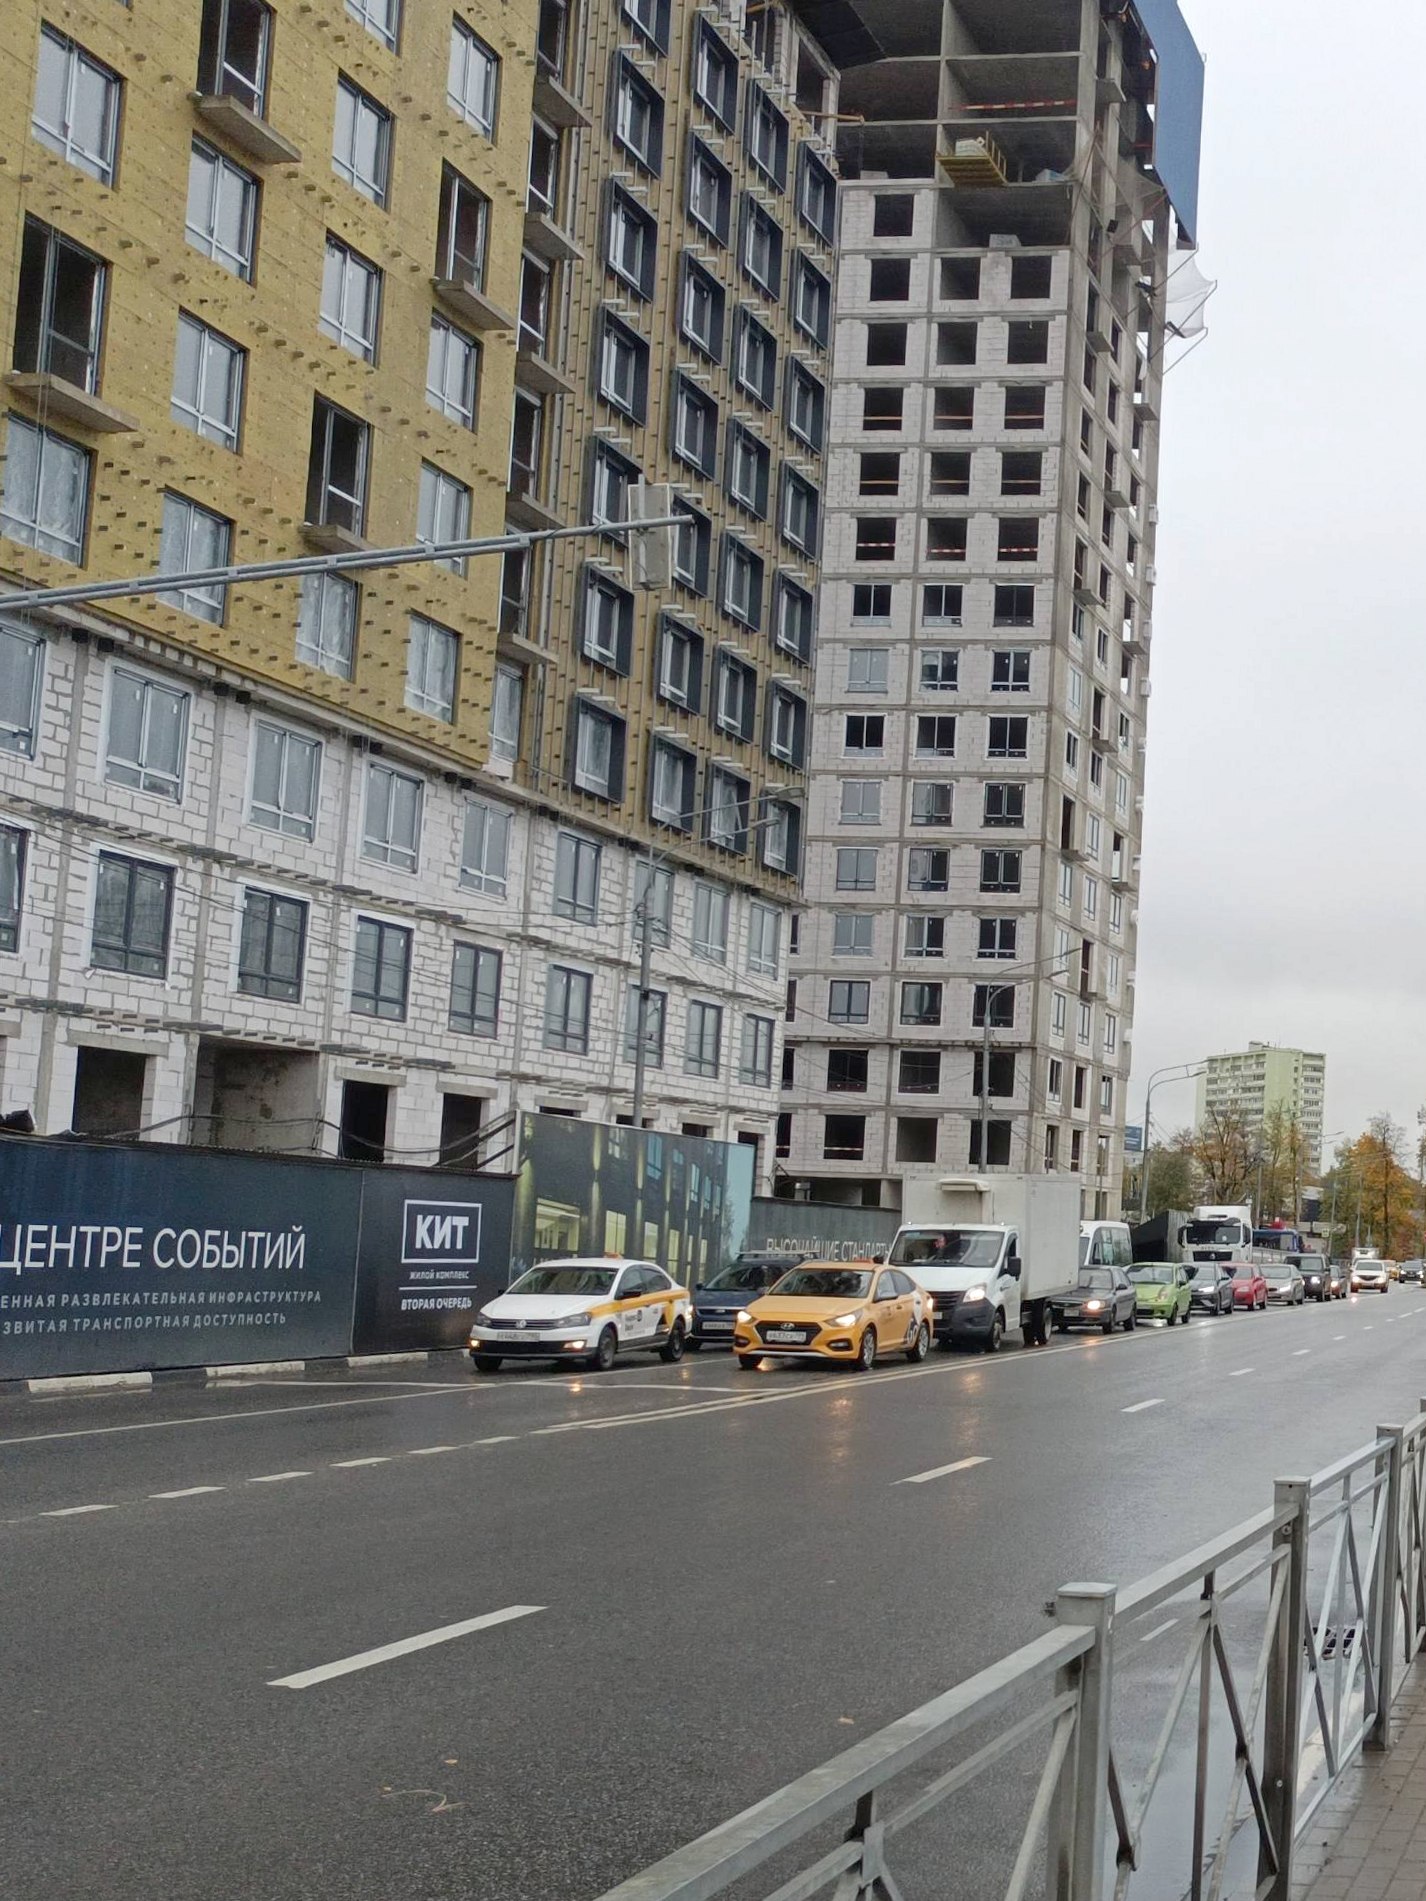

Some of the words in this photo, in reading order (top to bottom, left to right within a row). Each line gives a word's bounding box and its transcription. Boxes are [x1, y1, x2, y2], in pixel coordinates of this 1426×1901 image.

[415, 1214, 469, 1250] КИТ
[0, 1224, 144, 1275] ЦЕНТРЕ
[153, 1225, 306, 1270] СОБЫТИЙ
[61, 1291, 207, 1307] РАЗВЛЕКАТЕЛЬНАЯ
[209, 1290, 322, 1304] ИНФРАСТРУКТУРА
[401, 1298, 435, 1311] ВТОРАЯ
[436, 1297, 473, 1310] ОЧЕРЕДЬ
[73, 1315, 190, 1333] ТРАНСПОРТНАЯ
[193, 1312, 287, 1329] ДОСТУПНОСТЬ
